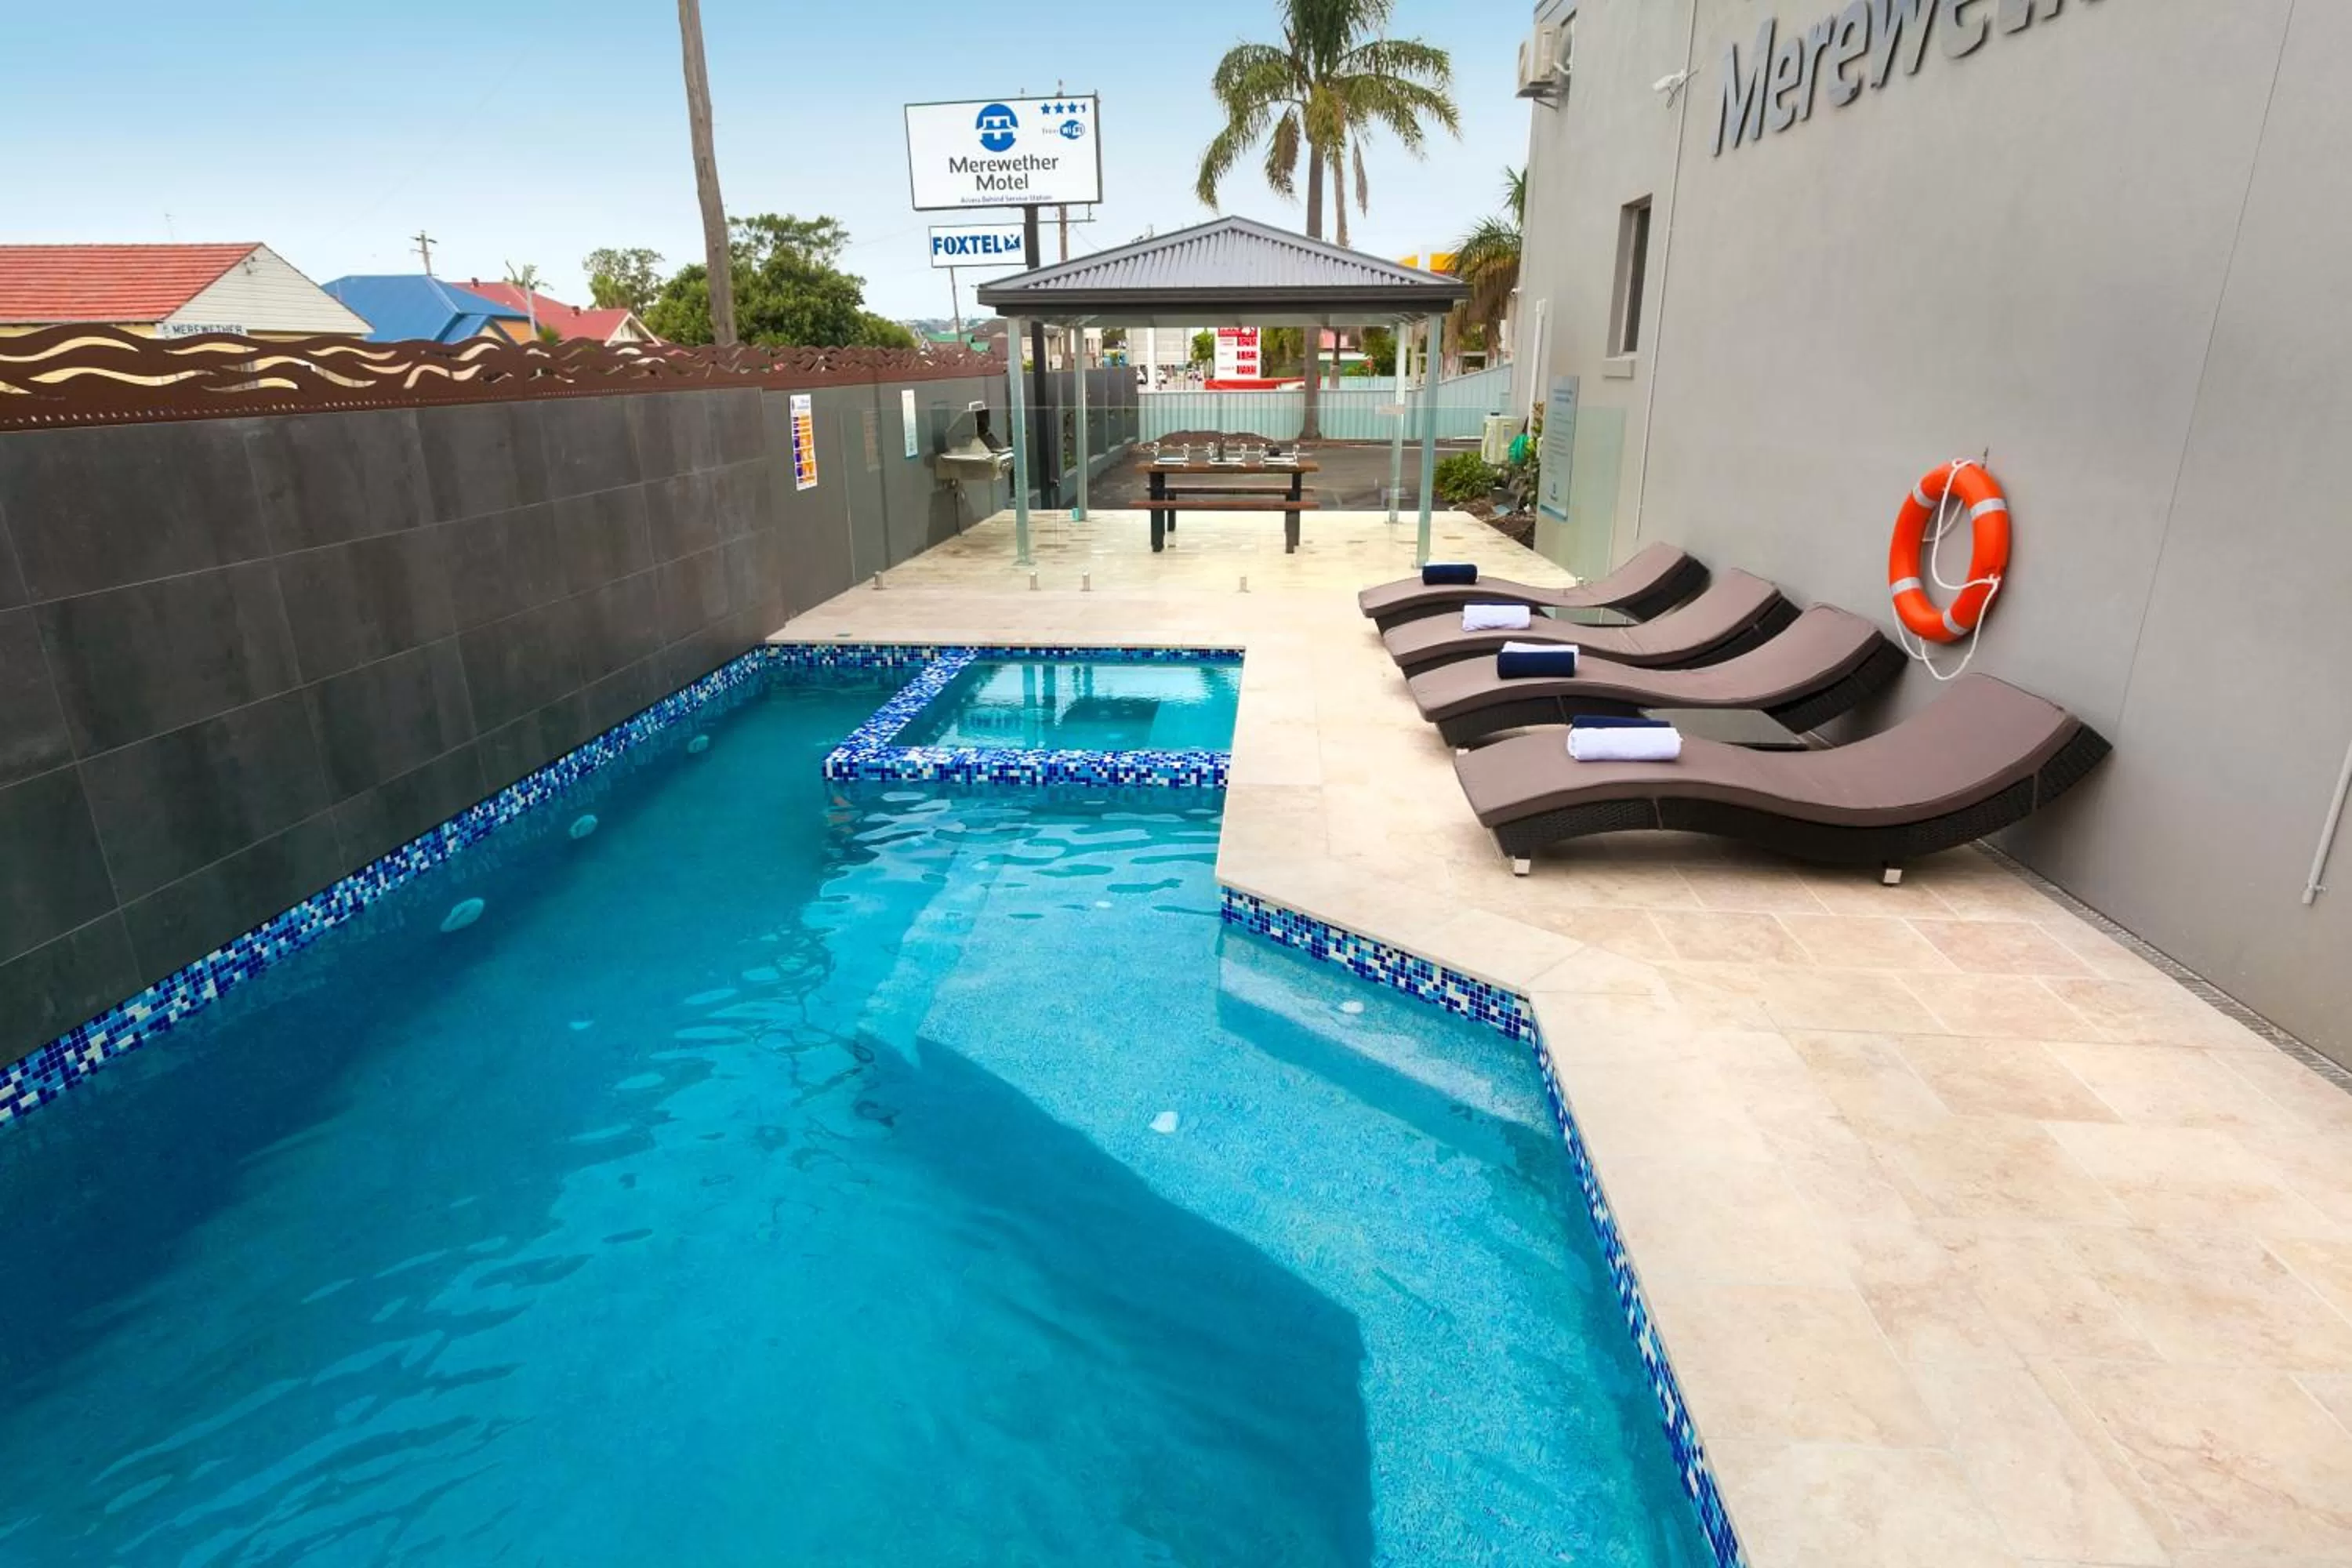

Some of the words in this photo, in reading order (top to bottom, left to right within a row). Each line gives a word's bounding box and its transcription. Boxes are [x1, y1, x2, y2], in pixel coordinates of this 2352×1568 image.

[1710, 0, 2109, 158] Merewe
[949, 154, 1059, 174] Merewether
[975, 172, 1029, 191] Motel
[932, 234, 1003, 256] FOXTEL
